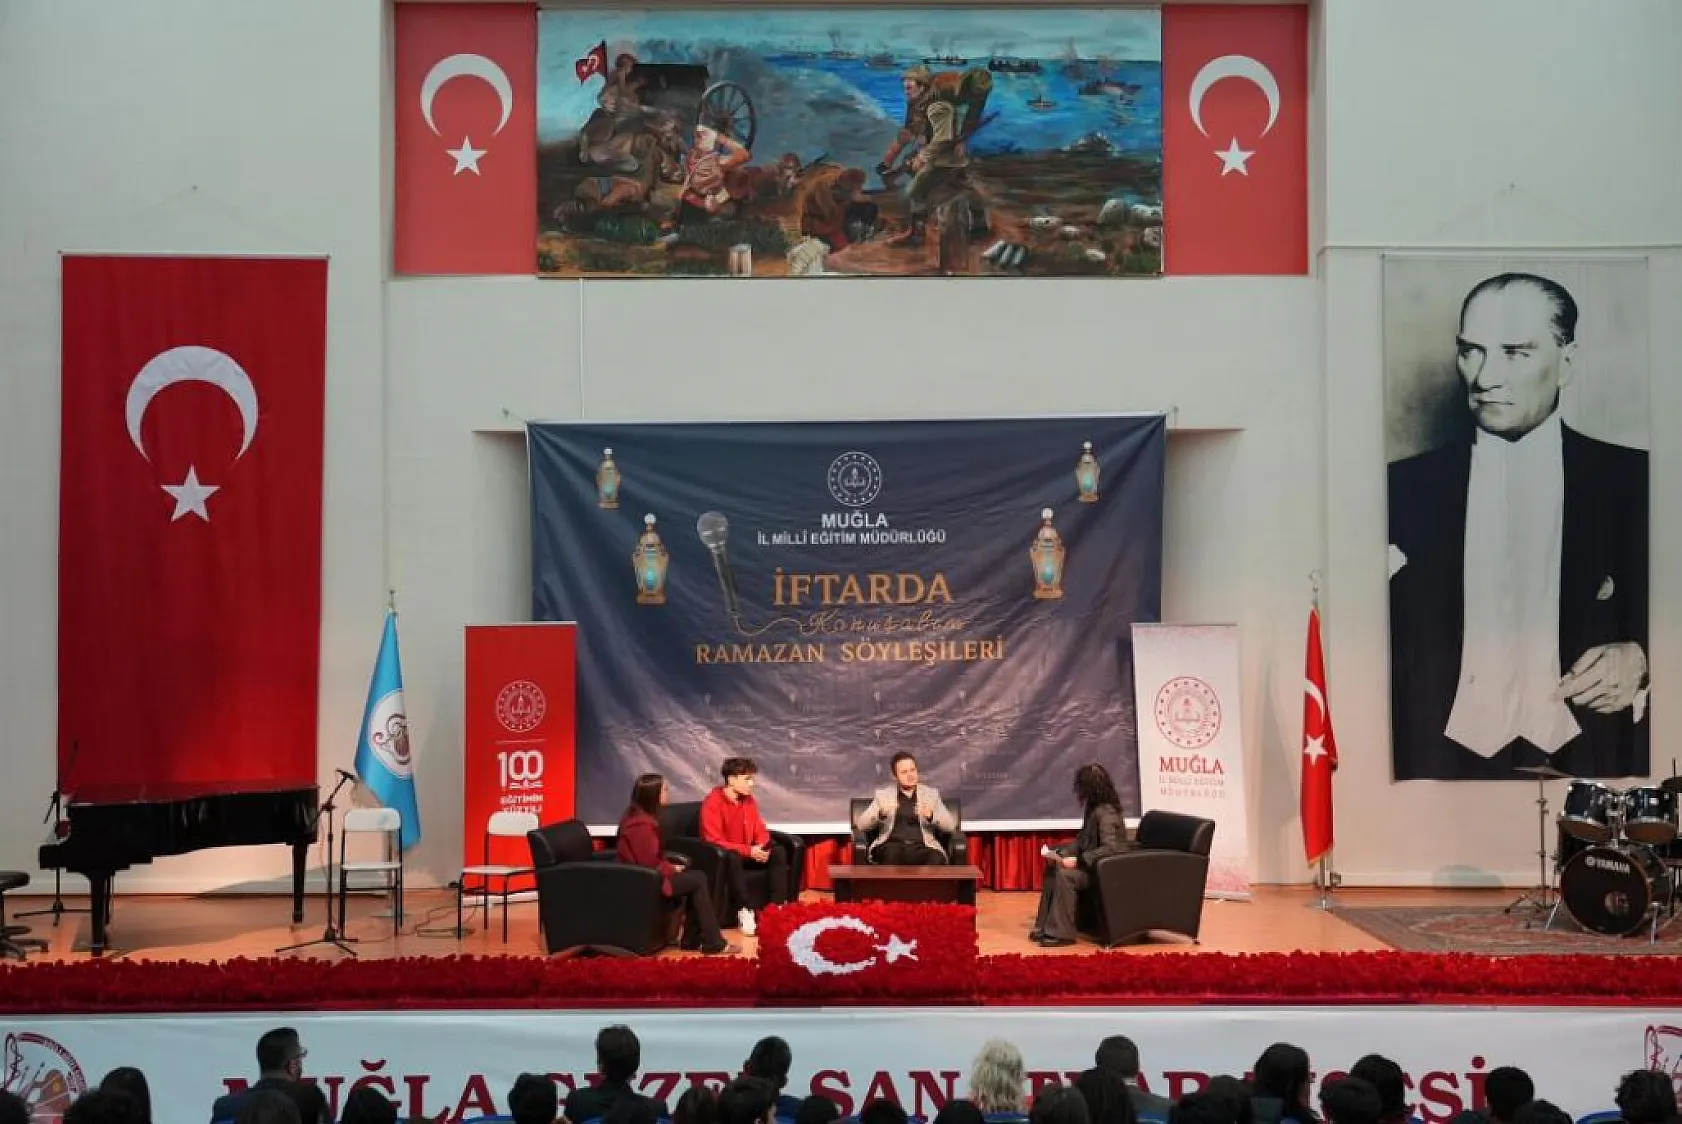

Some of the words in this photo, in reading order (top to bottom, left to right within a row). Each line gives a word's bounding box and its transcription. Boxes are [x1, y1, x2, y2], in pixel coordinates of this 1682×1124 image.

[821, 510, 889, 528] MUĞLA
[757, 529, 769, 545] İL
[772, 530, 807, 545] MİLLİ
[811, 530, 857, 545] EĞİTİM
[860, 528, 946, 544] MÜDÜRLÜĞÜ
[772, 566, 953, 606] İFTARDA
[696, 643, 824, 664] RAMAZAN
[840, 634, 1005, 667] SÖYLEŞİLERİ
[496, 750, 544, 789] 100
[1159, 753, 1224, 775] MUĞLA
[1596, 858, 1630, 874] YAMAHA
